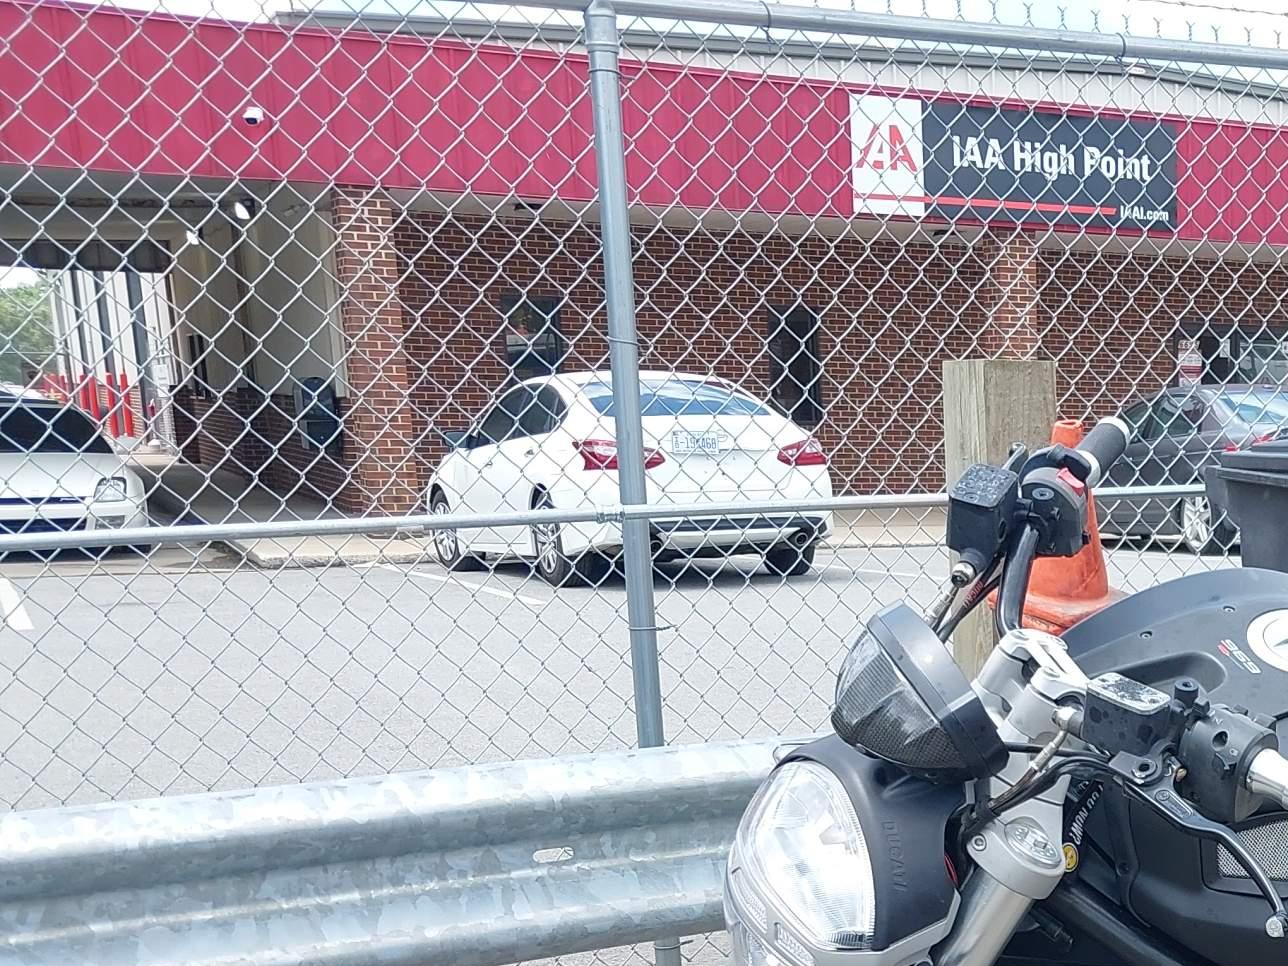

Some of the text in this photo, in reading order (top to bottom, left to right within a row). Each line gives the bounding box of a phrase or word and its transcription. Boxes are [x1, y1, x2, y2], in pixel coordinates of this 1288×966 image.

[953, 135, 1151, 181] IAA High Point
